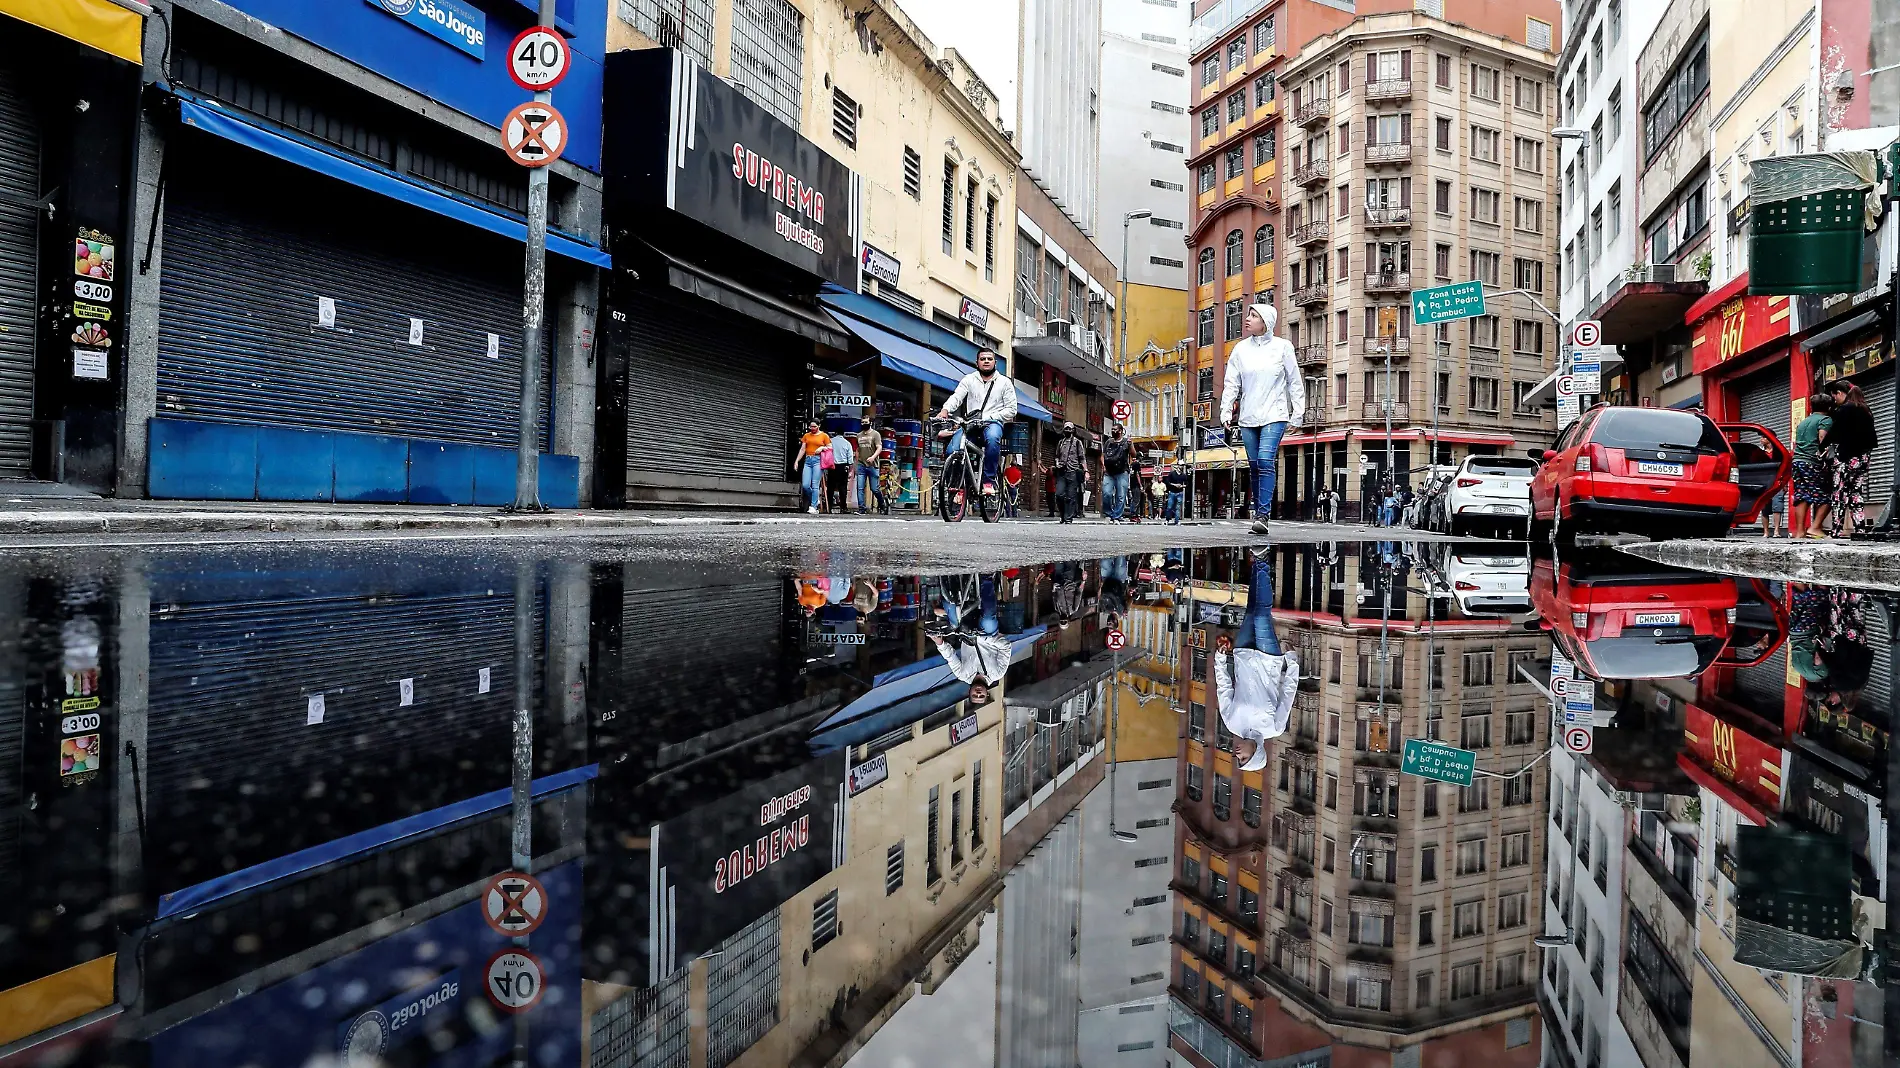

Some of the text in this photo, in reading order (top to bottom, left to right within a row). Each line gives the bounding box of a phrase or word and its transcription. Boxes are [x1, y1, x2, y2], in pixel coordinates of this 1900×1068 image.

[418, 0, 484, 45] São Jorge
[518, 42, 558, 67] 40
[733, 143, 824, 225] SUPREMA
[776, 211, 824, 254] Bijuterias
[872, 260, 897, 284] Fernando
[82, 284, 110, 298] 3,00
[1429, 286, 1475, 299] Zona Leste
[1430, 296, 1479, 309] Pq. D. Pedro
[612, 310, 626, 322] 672
[1431, 307, 1466, 319] Cambuci
[1582, 328, 1591, 341] E
[1721, 310, 1745, 361] 661
[1564, 380, 1571, 391] E
[814, 396, 870, 405] ENTRADA
